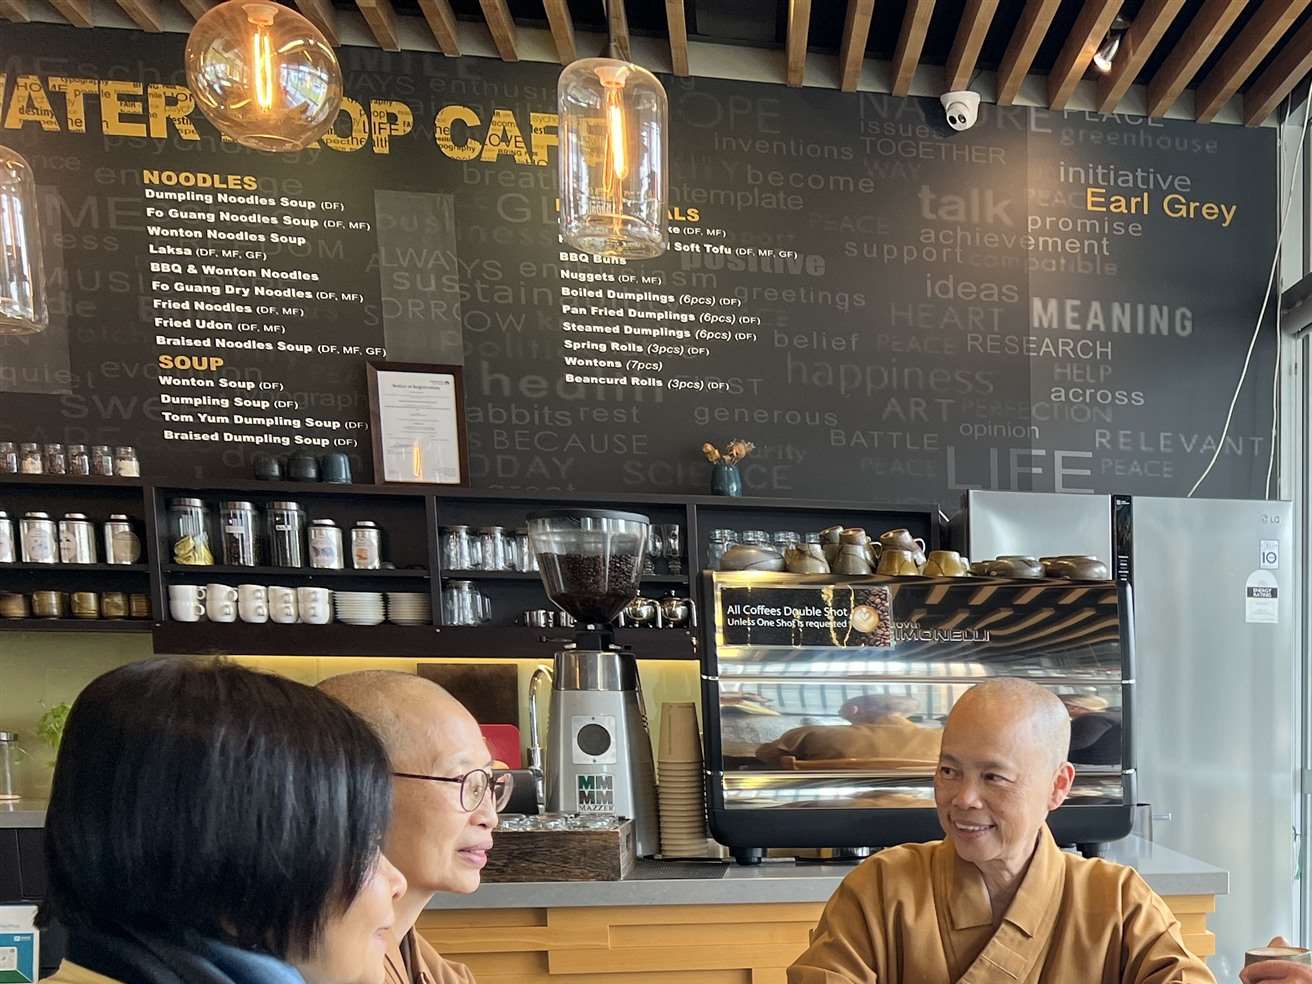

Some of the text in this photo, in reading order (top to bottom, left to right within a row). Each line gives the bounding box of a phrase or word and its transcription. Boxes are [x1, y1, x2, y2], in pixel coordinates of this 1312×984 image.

[0, 73, 201, 141] ATER
[713, 131, 854, 161] inventions
[864, 137, 1007, 165] TOGETHER
[143, 169, 257, 190] NOODLES
[746, 166, 875, 193] become
[1059, 161, 1192, 192] initiative
[144, 188, 213, 204] Dumpling
[217, 192, 276, 206] Noodles
[279, 197, 316, 210] Soup
[918, 184, 1016, 225] talk
[1086, 187, 1238, 228] Earl Grey
[146, 207, 164, 217] Fo
[168, 208, 215, 223] Guang
[219, 211, 279, 224] Noodles
[282, 215, 319, 229] Soup
[1027, 215, 1143, 238] promise
[146, 225, 306, 246] Wonton Noodles Soup
[919, 225, 1111, 256] achievement
[149, 244, 192, 255] Laksa
[559, 251, 590, 264] BBQ
[674, 241, 701, 253] Soft
[703, 243, 732, 255] Tofu
[844, 240, 964, 265] support
[150, 262, 319, 281] BBQ & Wonton Noodles
[560, 269, 615, 282] Nuggets
[151, 280, 170, 291] Fo
[173, 281, 221, 296] Guang
[224, 284, 250, 297] Dry
[254, 285, 313, 299] Noodles
[561, 286, 603, 298] Boiled
[606, 289, 675, 304] Dumplings
[733, 282, 868, 313] greetings
[925, 274, 1020, 303] ideas
[153, 298, 190, 310] Fried
[193, 300, 252, 313] Noodles
[562, 304, 587, 315] Pan
[590, 306, 624, 317] Fried
[627, 308, 695, 323] Dumplings
[154, 317, 191, 328] Fried
[195, 319, 233, 330] Udon
[890, 303, 1006, 332] HEART
[1032, 296, 1194, 337] MEANING
[562, 321, 620, 334] Steamed
[623, 325, 691, 339] Dumplings
[155, 335, 211, 347] Braised
[215, 338, 273, 350] Noodles
[277, 341, 313, 354] Soup
[563, 339, 607, 352] Spring
[610, 341, 644, 352] Rolls
[773, 330, 860, 352] belief
[966, 333, 1113, 360] RESEARCH
[158, 355, 224, 371] SOUP
[564, 356, 622, 368] Wontons
[158, 375, 215, 387] Wonton
[218, 378, 255, 391] Soup
[565, 373, 627, 385] Beancurd
[630, 376, 663, 387] Rolls
[785, 350, 995, 398] happiness
[1053, 362, 1113, 384] HELP
[160, 393, 229, 408] Dumpling
[233, 397, 270, 410] Soup
[1049, 385, 1145, 406] across
[161, 411, 196, 423] Tom
[197, 412, 230, 424] Yum
[233, 414, 301, 429] Dumpling
[304, 417, 341, 430] Soup
[578, 404, 641, 424] rest
[693, 404, 839, 428] generous
[881, 398, 953, 423] ART
[163, 429, 219, 441] Braised
[223, 432, 290, 446] Dumpling
[294, 435, 330, 447] Soup
[830, 429, 940, 451] BATTLE
[959, 421, 1040, 440] opinion
[493, 429, 649, 455] BECAUSE
[1095, 429, 1266, 457] RELEVANT
[946, 445, 1096, 495] LIFE
[726, 604, 849, 618] All Coffees Double Shot
[727, 617, 848, 630] Unless One Shot is requested
[890, 628, 991, 642] IMONELLI
